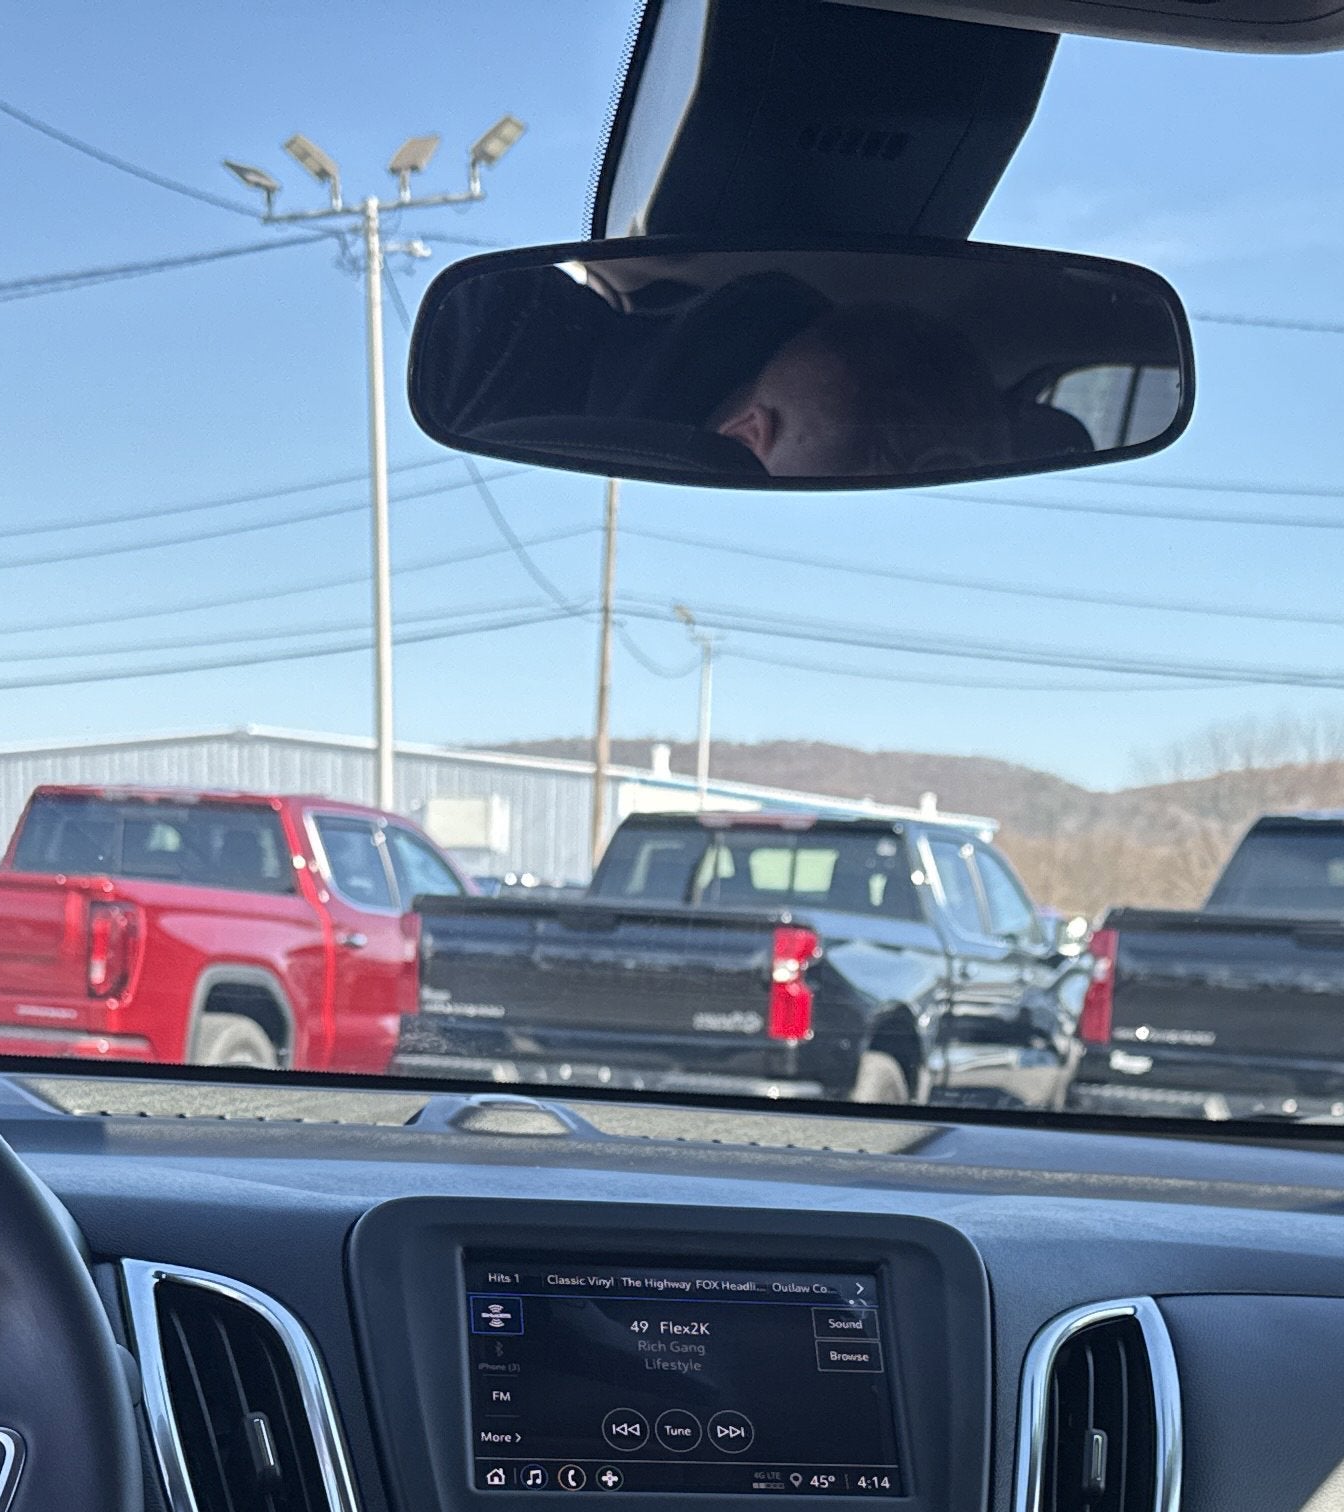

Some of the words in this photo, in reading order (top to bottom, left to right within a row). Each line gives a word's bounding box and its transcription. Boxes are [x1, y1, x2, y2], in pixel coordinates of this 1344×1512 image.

[488, 1273, 511, 1283] Hits
[514, 1273, 520, 1283] 1
[547, 1275, 586, 1286] Classic
[587, 1276, 614, 1288] Vinyl
[621, 1277, 641, 1287] The
[645, 1278, 691, 1292] Highway
[696, 1280, 719, 1290] FOX
[772, 1283, 810, 1293] Outlaw
[630, 1320, 649, 1333] 49
[660, 1321, 710, 1335] Flex2K
[828, 1318, 863, 1330] Sound
[637, 1340, 667, 1352] Rich
[669, 1341, 705, 1356] Gang
[830, 1350, 869, 1362] Browse
[644, 1358, 702, 1374] Lifestyle
[492, 1390, 511, 1401] FM
[481, 1431, 512, 1442] More
[664, 1425, 692, 1437] Tune
[857, 1476, 891, 1489] 4:14
